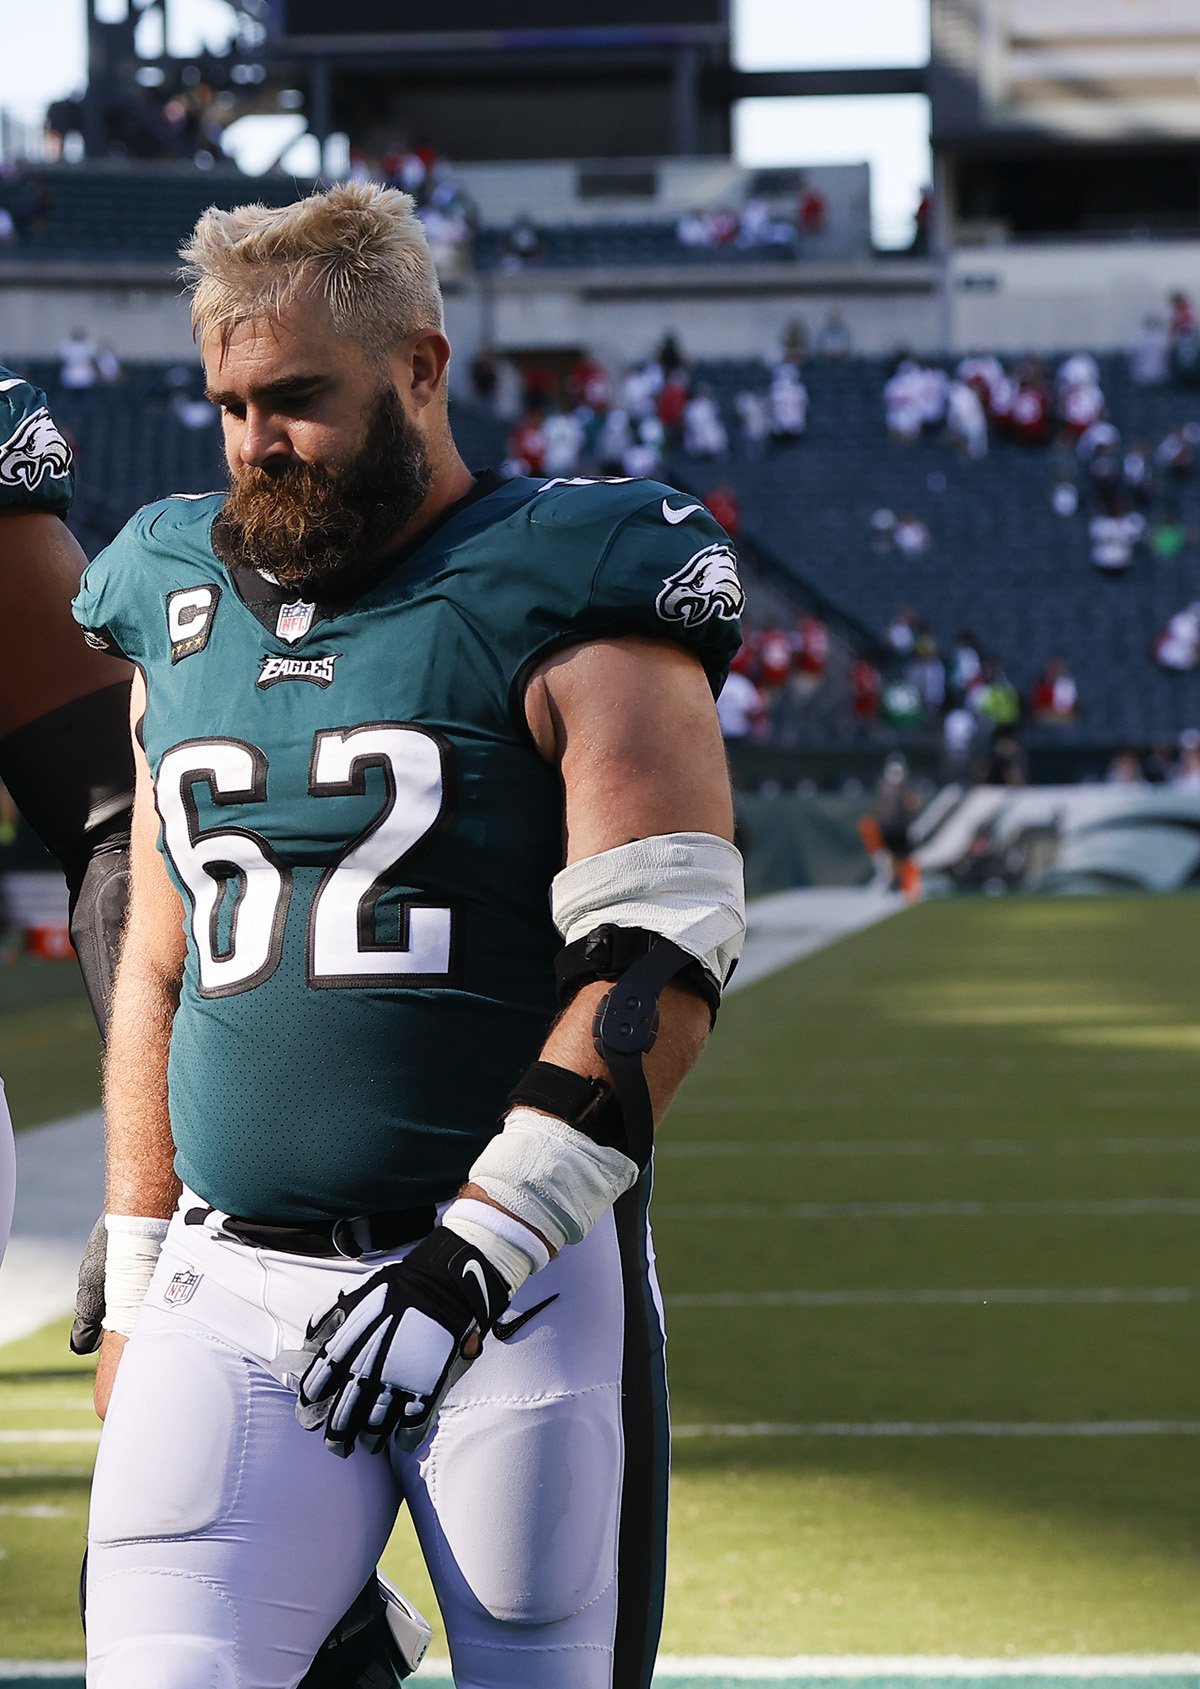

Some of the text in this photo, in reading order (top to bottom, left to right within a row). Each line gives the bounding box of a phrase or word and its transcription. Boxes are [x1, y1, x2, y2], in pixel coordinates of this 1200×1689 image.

[169, 588, 211, 643] C
[282, 617, 304, 632] NFL
[257, 654, 339, 683] EAGLES
[156, 721, 456, 998] 62
